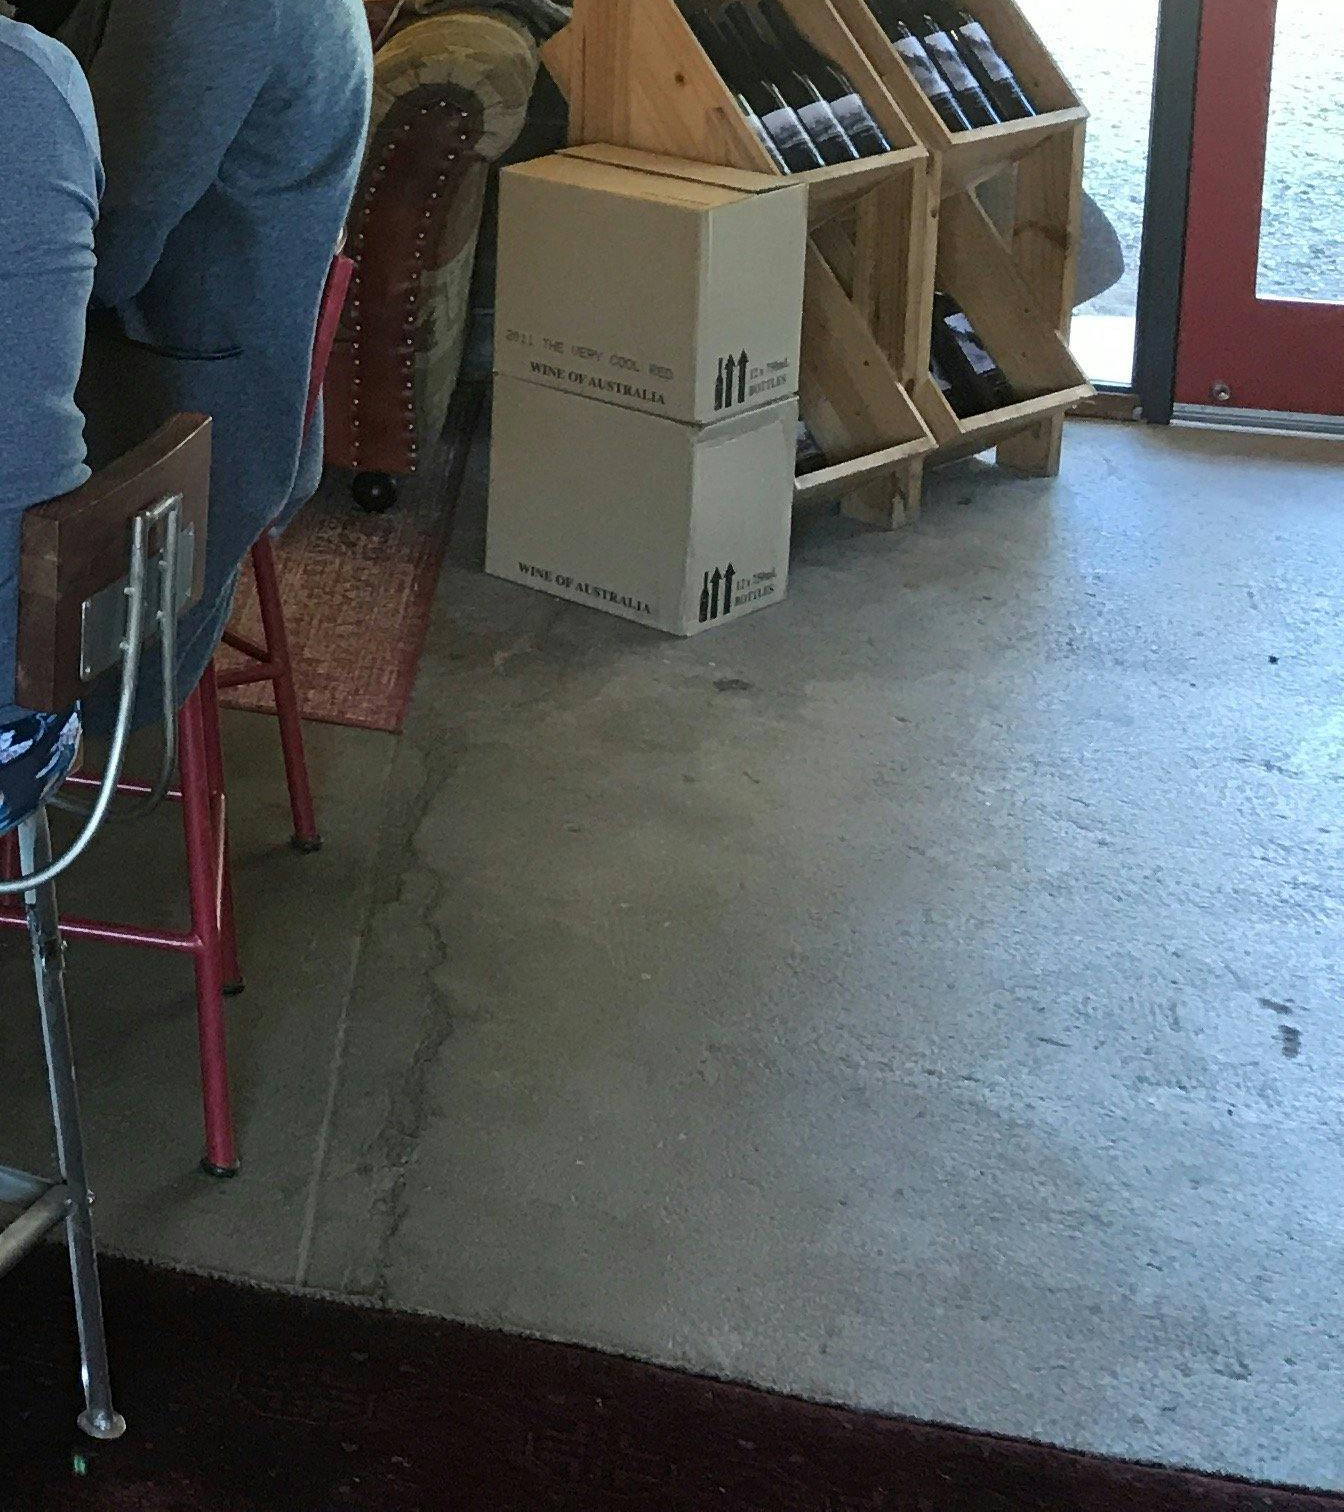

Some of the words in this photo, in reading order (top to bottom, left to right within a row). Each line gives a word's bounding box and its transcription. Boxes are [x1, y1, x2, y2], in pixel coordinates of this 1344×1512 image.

[543, 338, 564, 354] THE
[571, 345, 604, 362] VERY
[610, 354, 640, 372] COOL
[530, 361, 566, 380] WINE
[568, 371, 588, 385] OF
[588, 377, 666, 405] AUSTRALIA
[518, 561, 553, 582] WINE
[555, 574, 574, 588] OF
[574, 582, 651, 614] AUSTRALIA
